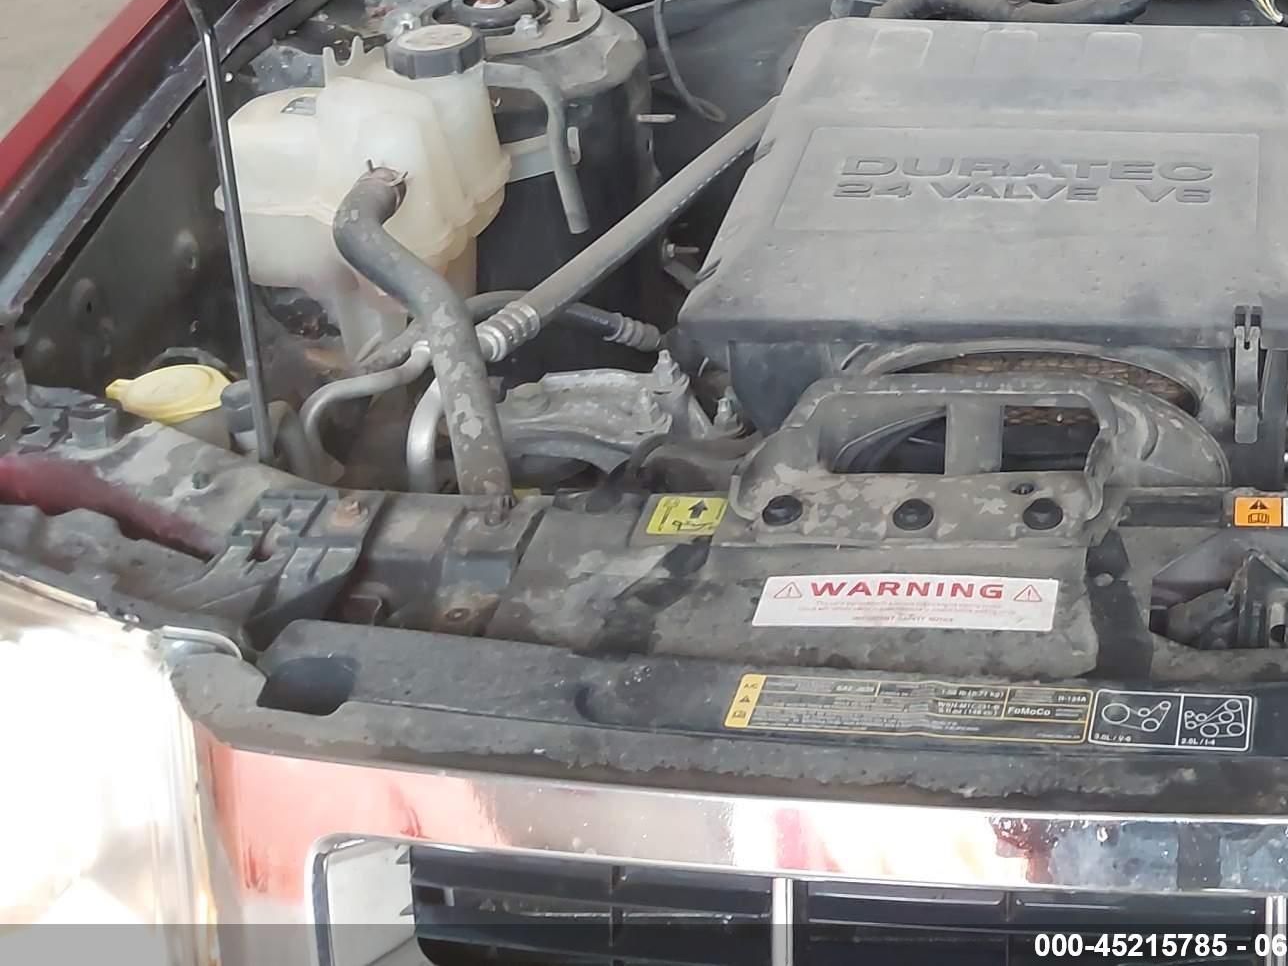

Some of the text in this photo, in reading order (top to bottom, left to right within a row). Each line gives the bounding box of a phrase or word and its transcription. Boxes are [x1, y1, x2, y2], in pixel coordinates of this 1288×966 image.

[840, 155, 1214, 181] DURATEC
[833, 181, 1212, 204] 24 VALVE V6
[810, 580, 1005, 600] WARNING
[1007, 706, 1052, 716] FoMoCo
